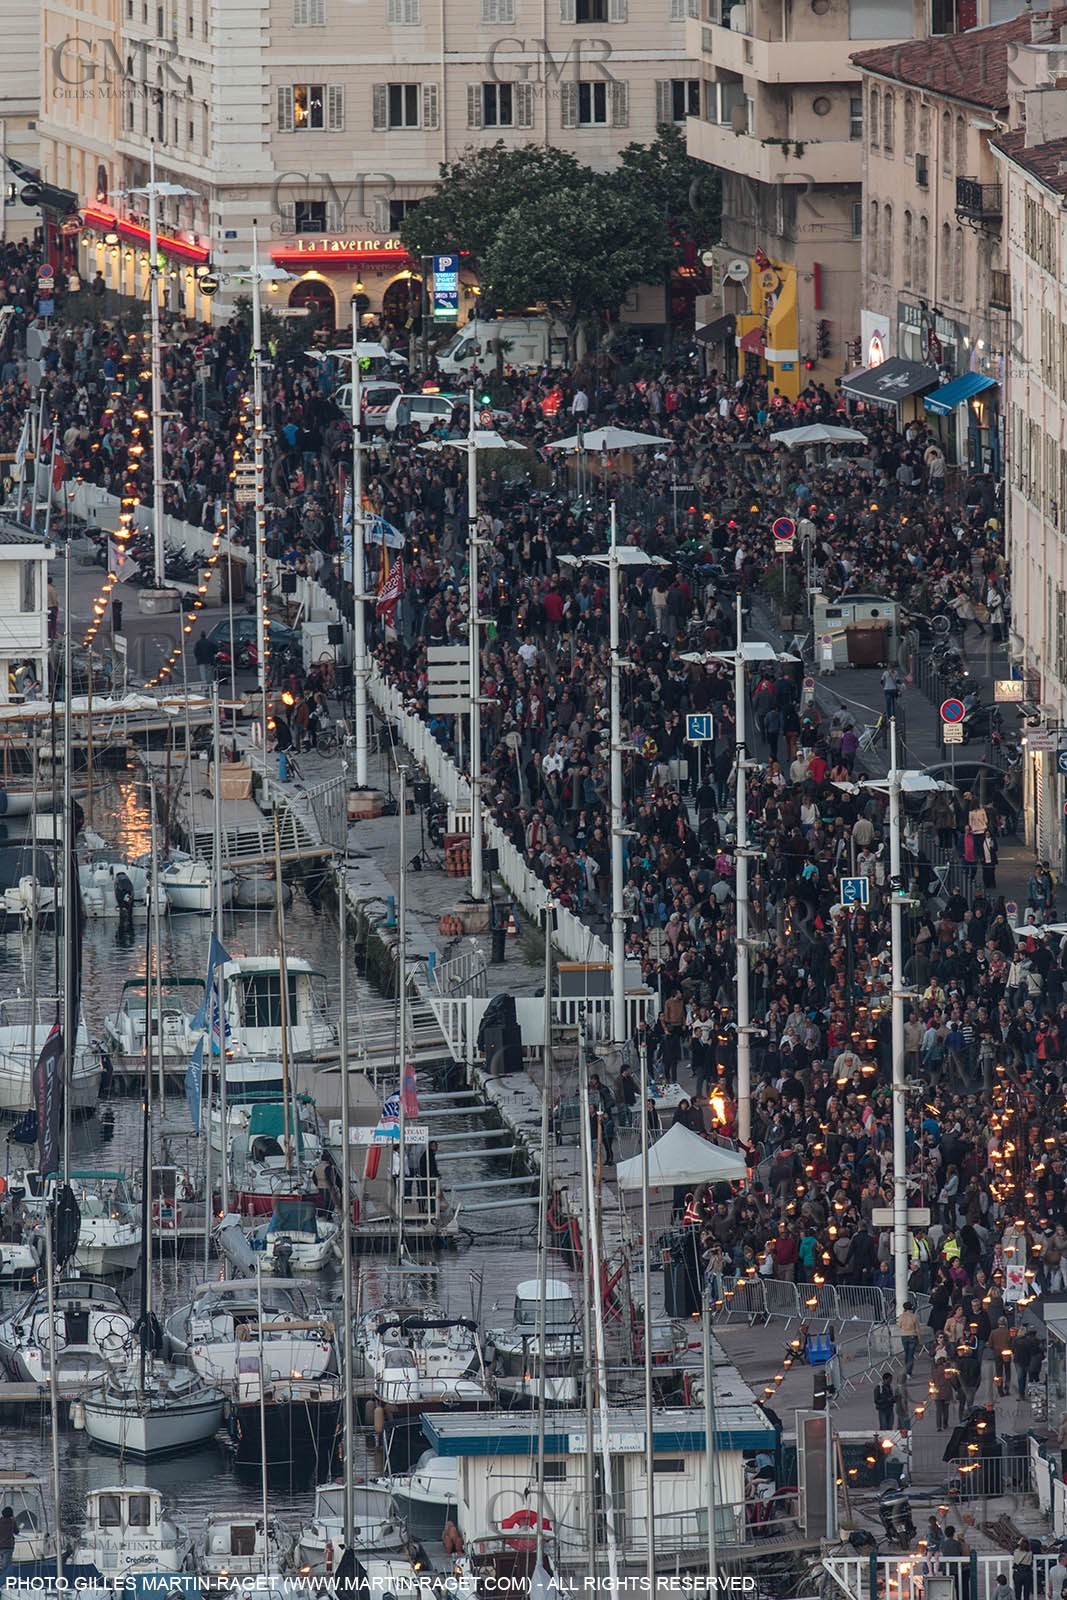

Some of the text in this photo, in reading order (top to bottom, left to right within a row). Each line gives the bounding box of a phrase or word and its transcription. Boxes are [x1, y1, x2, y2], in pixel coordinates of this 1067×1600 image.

[298, 239, 401, 252] La Taverne de
